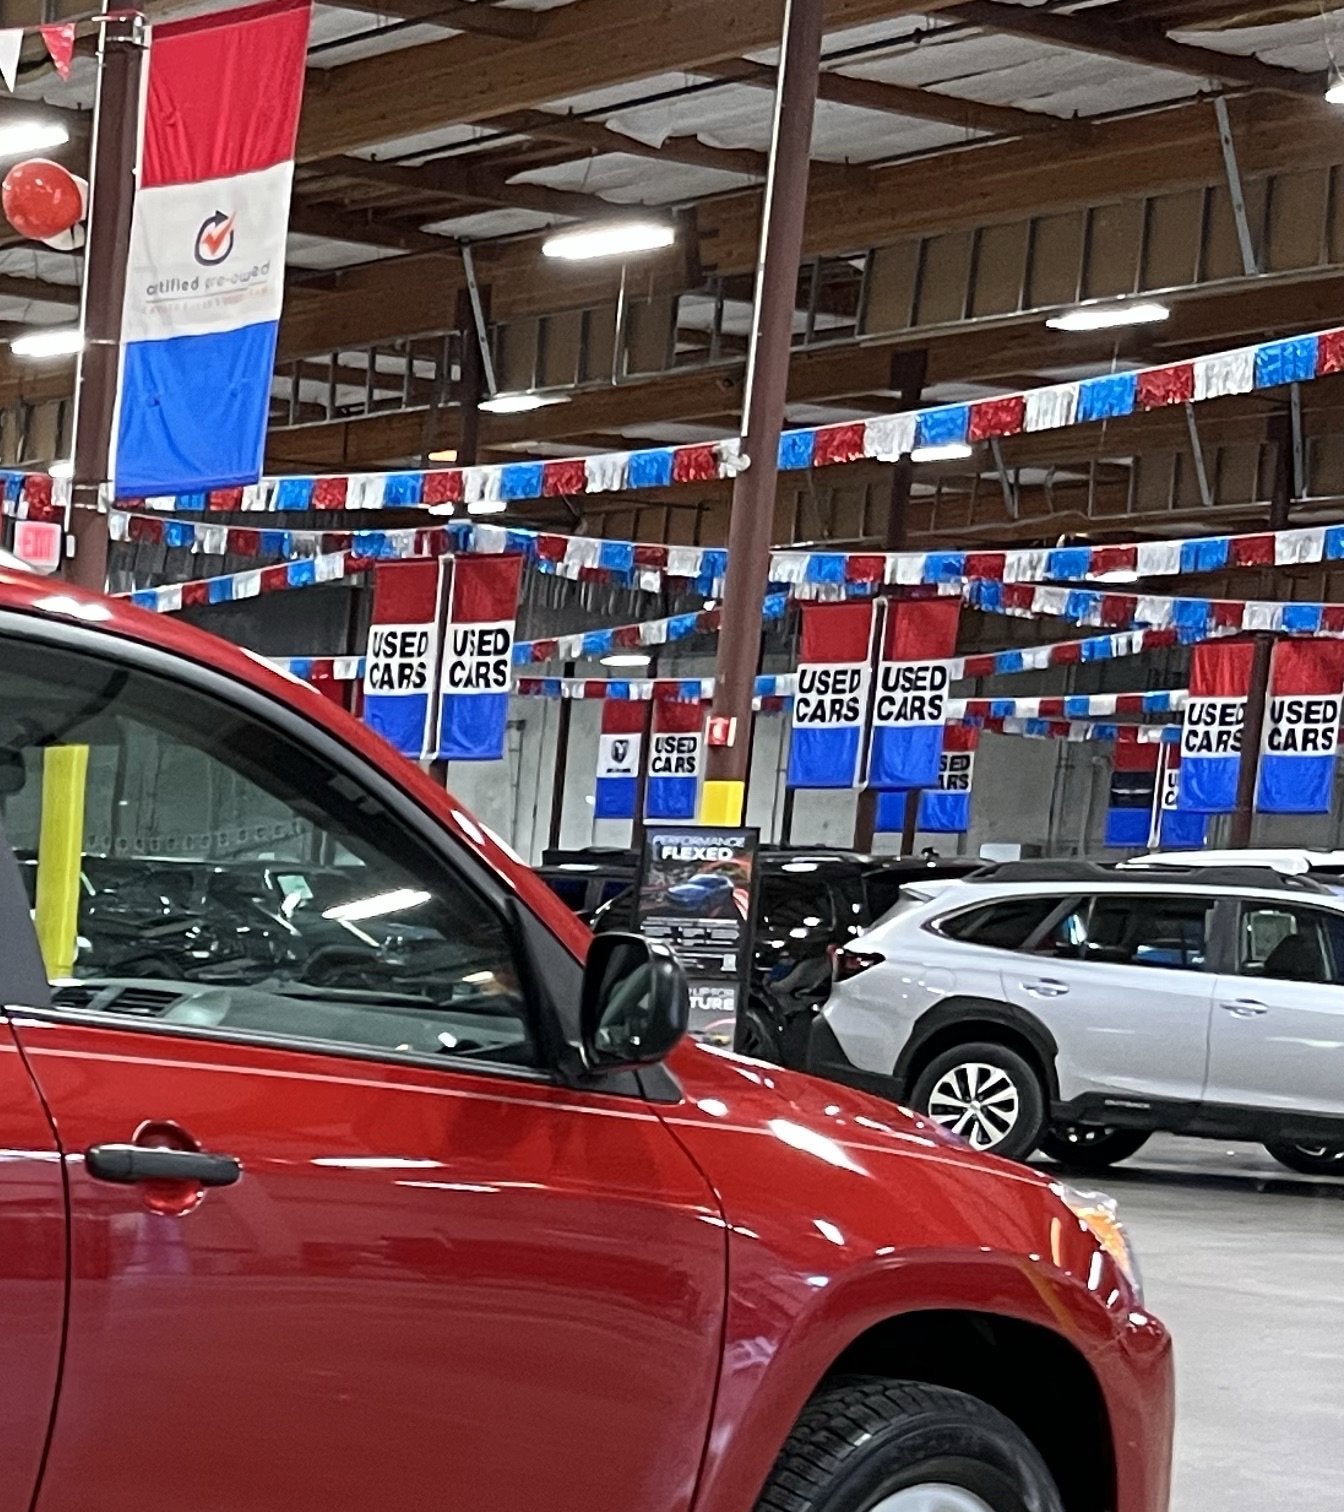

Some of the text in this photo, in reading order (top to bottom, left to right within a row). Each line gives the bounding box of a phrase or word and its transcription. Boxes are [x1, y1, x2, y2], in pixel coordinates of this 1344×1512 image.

[372, 631, 429, 658] USED
[369, 662, 427, 690] CARS
[449, 659, 508, 688] CARS
[798, 669, 861, 695] USED
[881, 665, 947, 693] USED
[796, 697, 860, 723] CARS
[877, 695, 944, 721] CARS
[1270, 700, 1338, 724] USED
[655, 736, 698, 754] USED
[1185, 729, 1244, 752] CARS
[1268, 727, 1335, 751] CARS
[652, 756, 696, 773] CARS
[940, 755, 971, 772] SED
[662, 846, 733, 861] FLEXED
